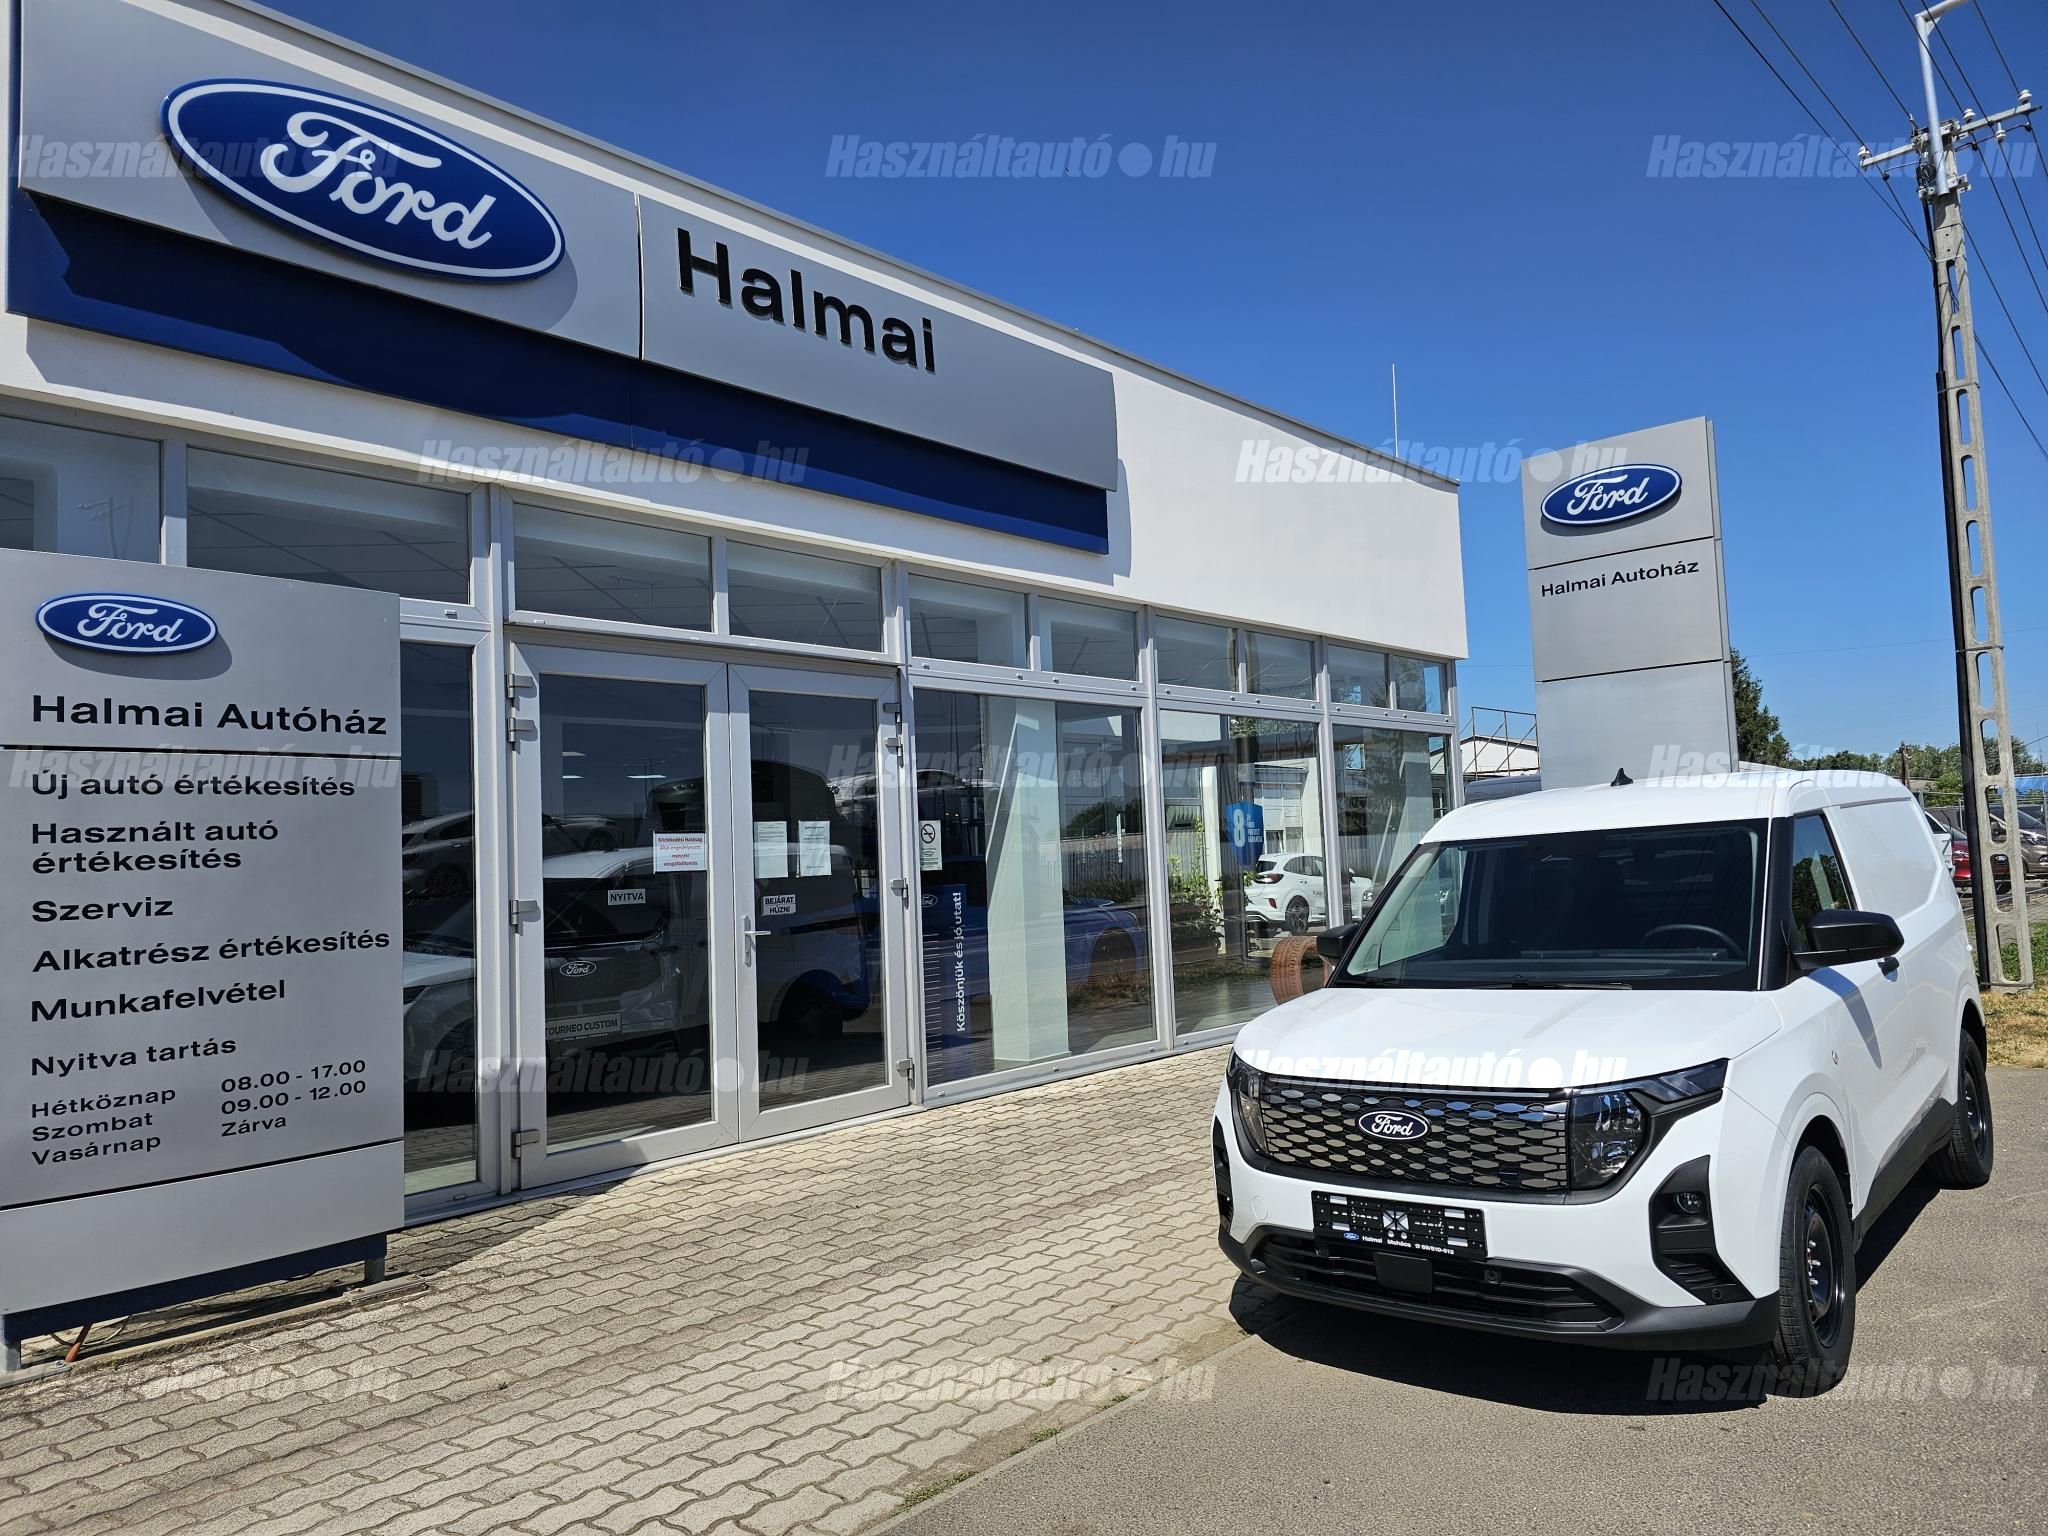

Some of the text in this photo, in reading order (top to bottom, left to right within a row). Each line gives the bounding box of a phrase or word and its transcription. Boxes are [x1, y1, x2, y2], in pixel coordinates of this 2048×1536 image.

[261, 111, 496, 250] Ford
[677, 227, 936, 374] Halmai
[1566, 474, 1650, 516] Ford
[1541, 561, 1700, 597] Halmai Autoház
[77, 602, 184, 644] Ford
[32, 694, 388, 736] Halmai Autóház
[32, 769, 356, 800] Új autó értékesítés
[32, 819, 279, 845] Használt autó
[1233, 809, 1245, 848] 8
[32, 848, 242, 875] értékesítés
[32, 897, 173, 922] Szerviz
[610, 892, 644, 902] NYITVA
[765, 895, 794, 905] BEJÁRAT
[32, 929, 390, 972] Alkatrész értékesítés
[953, 892, 966, 1032] Köszönjük és jó utat!
[31, 979, 286, 1022] Munkafelvétel
[584, 1018, 618, 1032] CUSTOM
[32, 1037, 237, 1078] Nyitva tartás
[32, 1086, 176, 1119] Hétköznap
[221, 1070, 290, 1093] 08.00
[310, 1059, 366, 1080] 17.00
[32, 1111, 153, 1142] Szombat
[221, 1091, 289, 1115] 09.00
[309, 1079, 366, 1102] 12.00
[1371, 1114, 1414, 1136] Ford
[32, 1113, 287, 1166] Vasárnap Zárva
